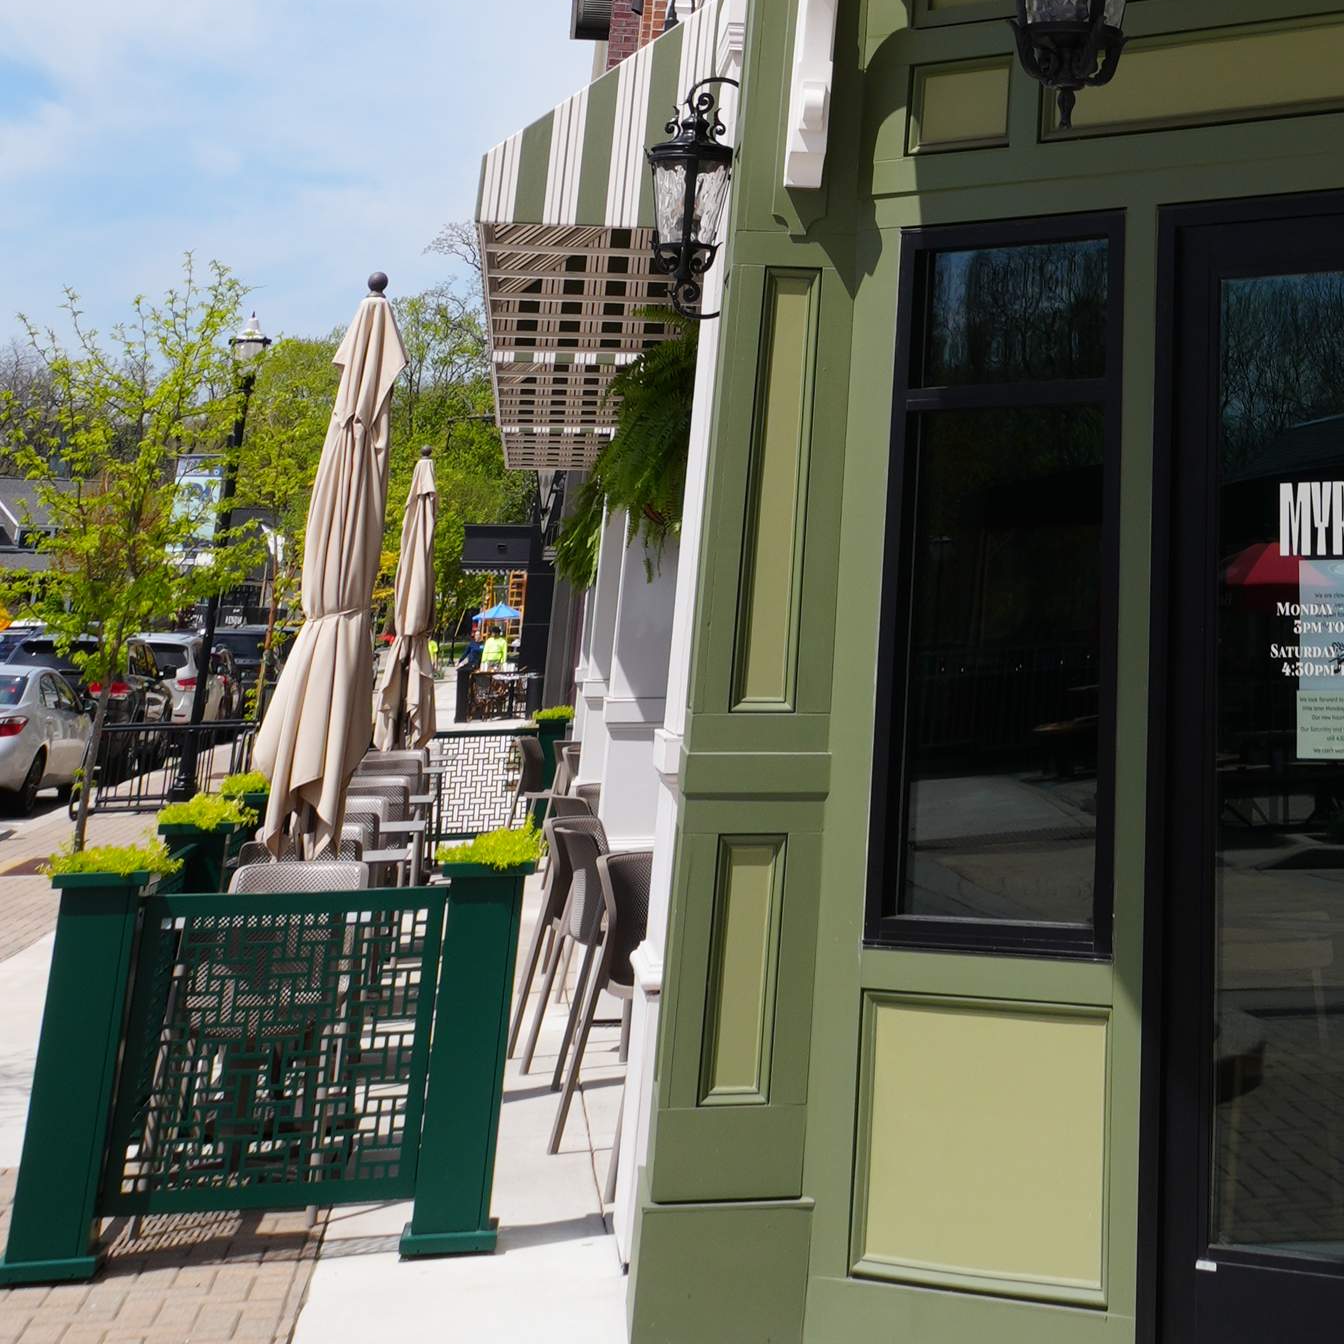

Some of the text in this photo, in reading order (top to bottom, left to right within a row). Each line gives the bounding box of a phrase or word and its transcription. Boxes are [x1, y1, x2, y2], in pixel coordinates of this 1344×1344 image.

[1276, 601, 1334, 616] MONDAY
[1326, 621, 1344, 633] TO
[1270, 643, 1337, 658] SATURDAY
